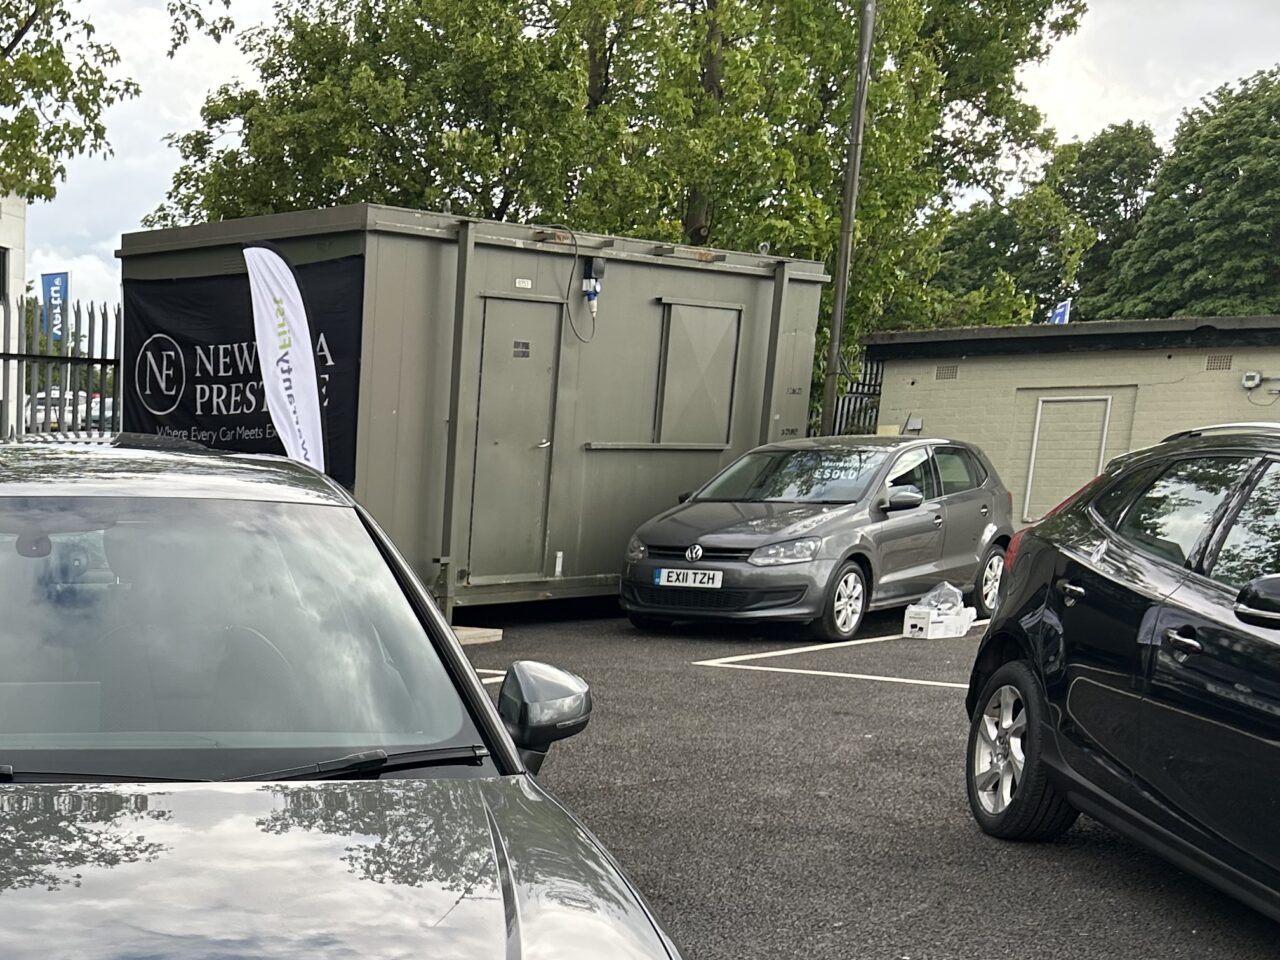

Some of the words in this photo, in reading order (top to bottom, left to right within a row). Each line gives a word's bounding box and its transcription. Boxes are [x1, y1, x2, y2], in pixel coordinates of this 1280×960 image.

[190, 426, 217, 445] Every
[220, 427, 235, 441] Car
[236, 425, 263, 439] Meets
[666, 570, 688, 584] EX11
[692, 571, 716, 585] TZH
